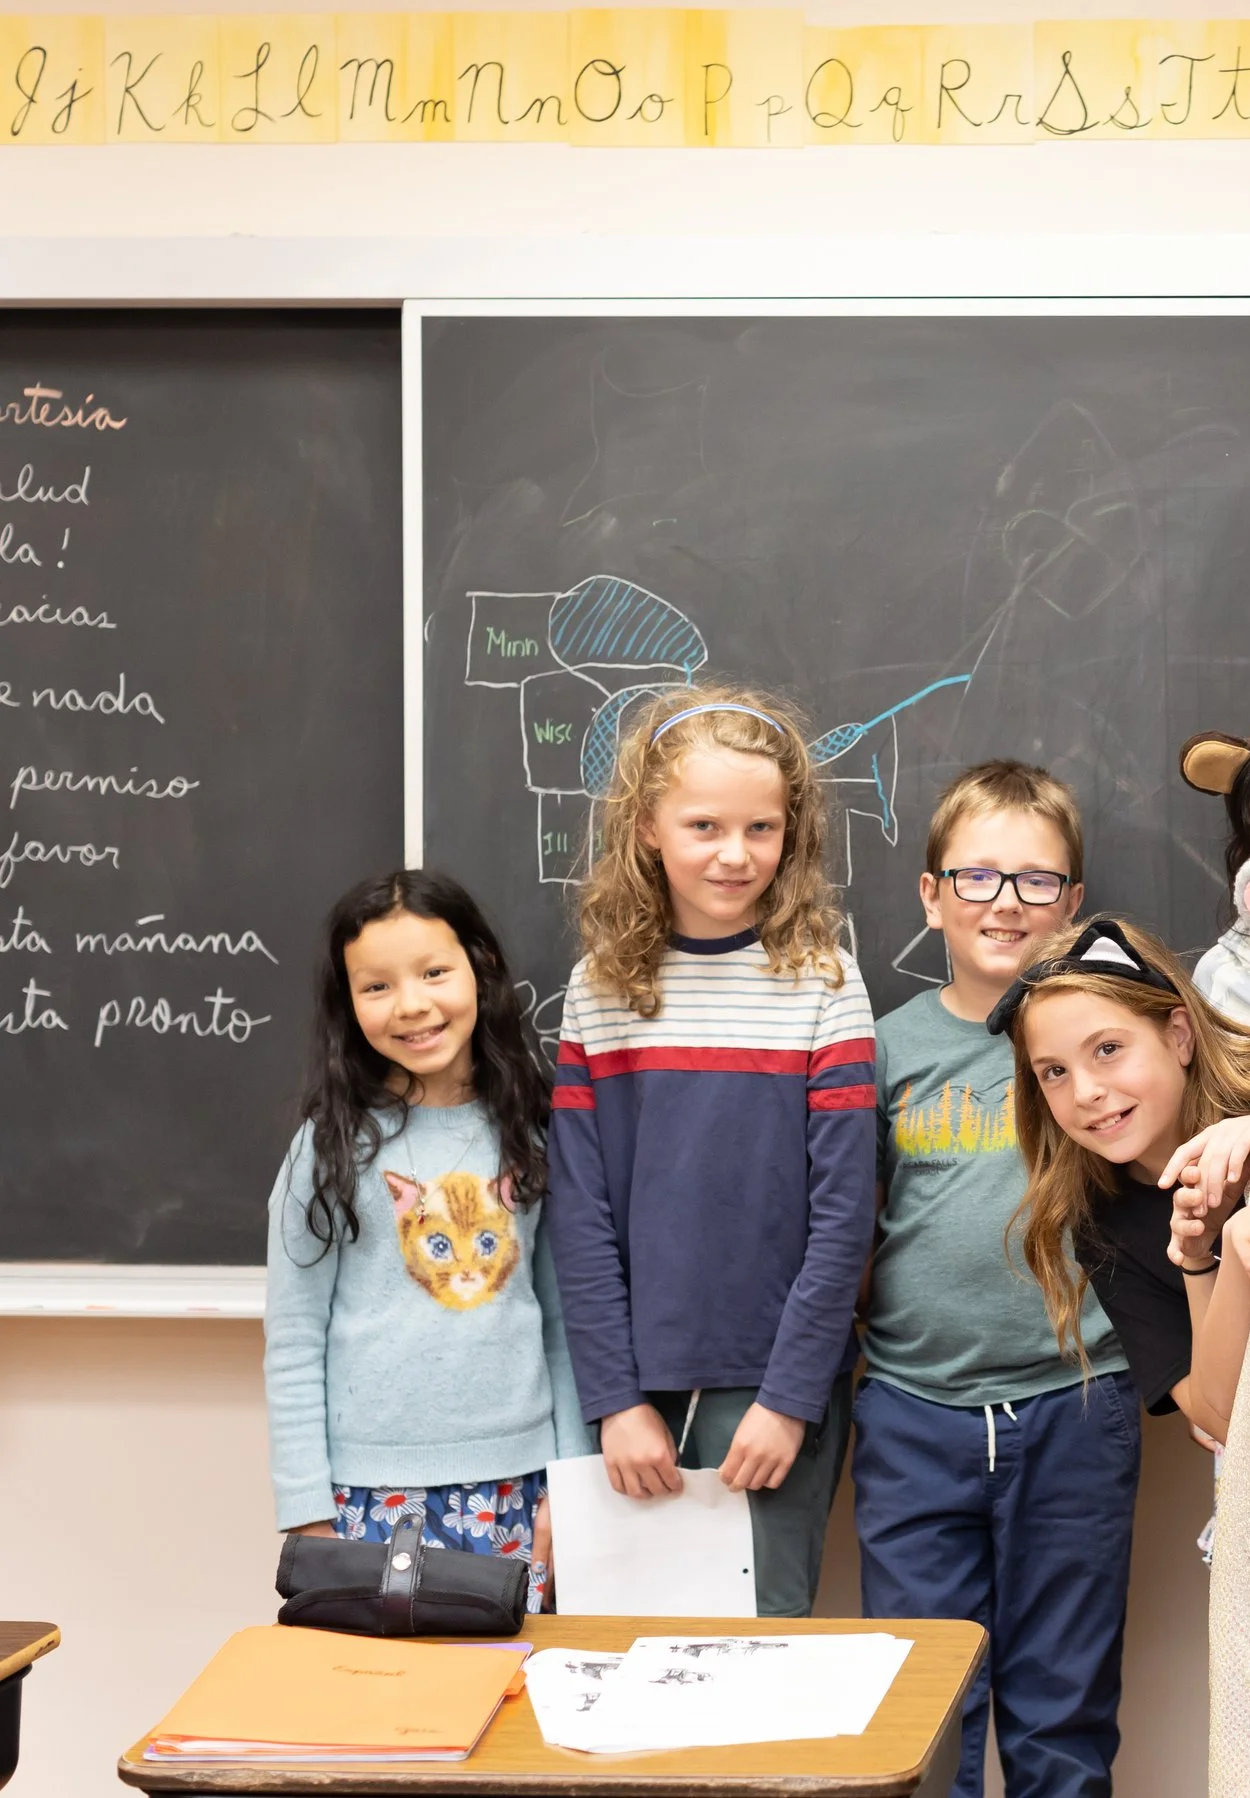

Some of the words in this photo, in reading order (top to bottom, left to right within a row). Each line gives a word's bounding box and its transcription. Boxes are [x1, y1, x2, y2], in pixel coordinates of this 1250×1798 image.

[0, 463, 91, 506] lud
[0, 594, 117, 629] acias
[486, 627, 539, 657] Minn
[32, 671, 165, 724] nada
[9, 765, 201, 811] permiso
[0, 831, 120, 889] favor
[75, 913, 280, 965] mañana
[94, 987, 272, 1047] pronto
